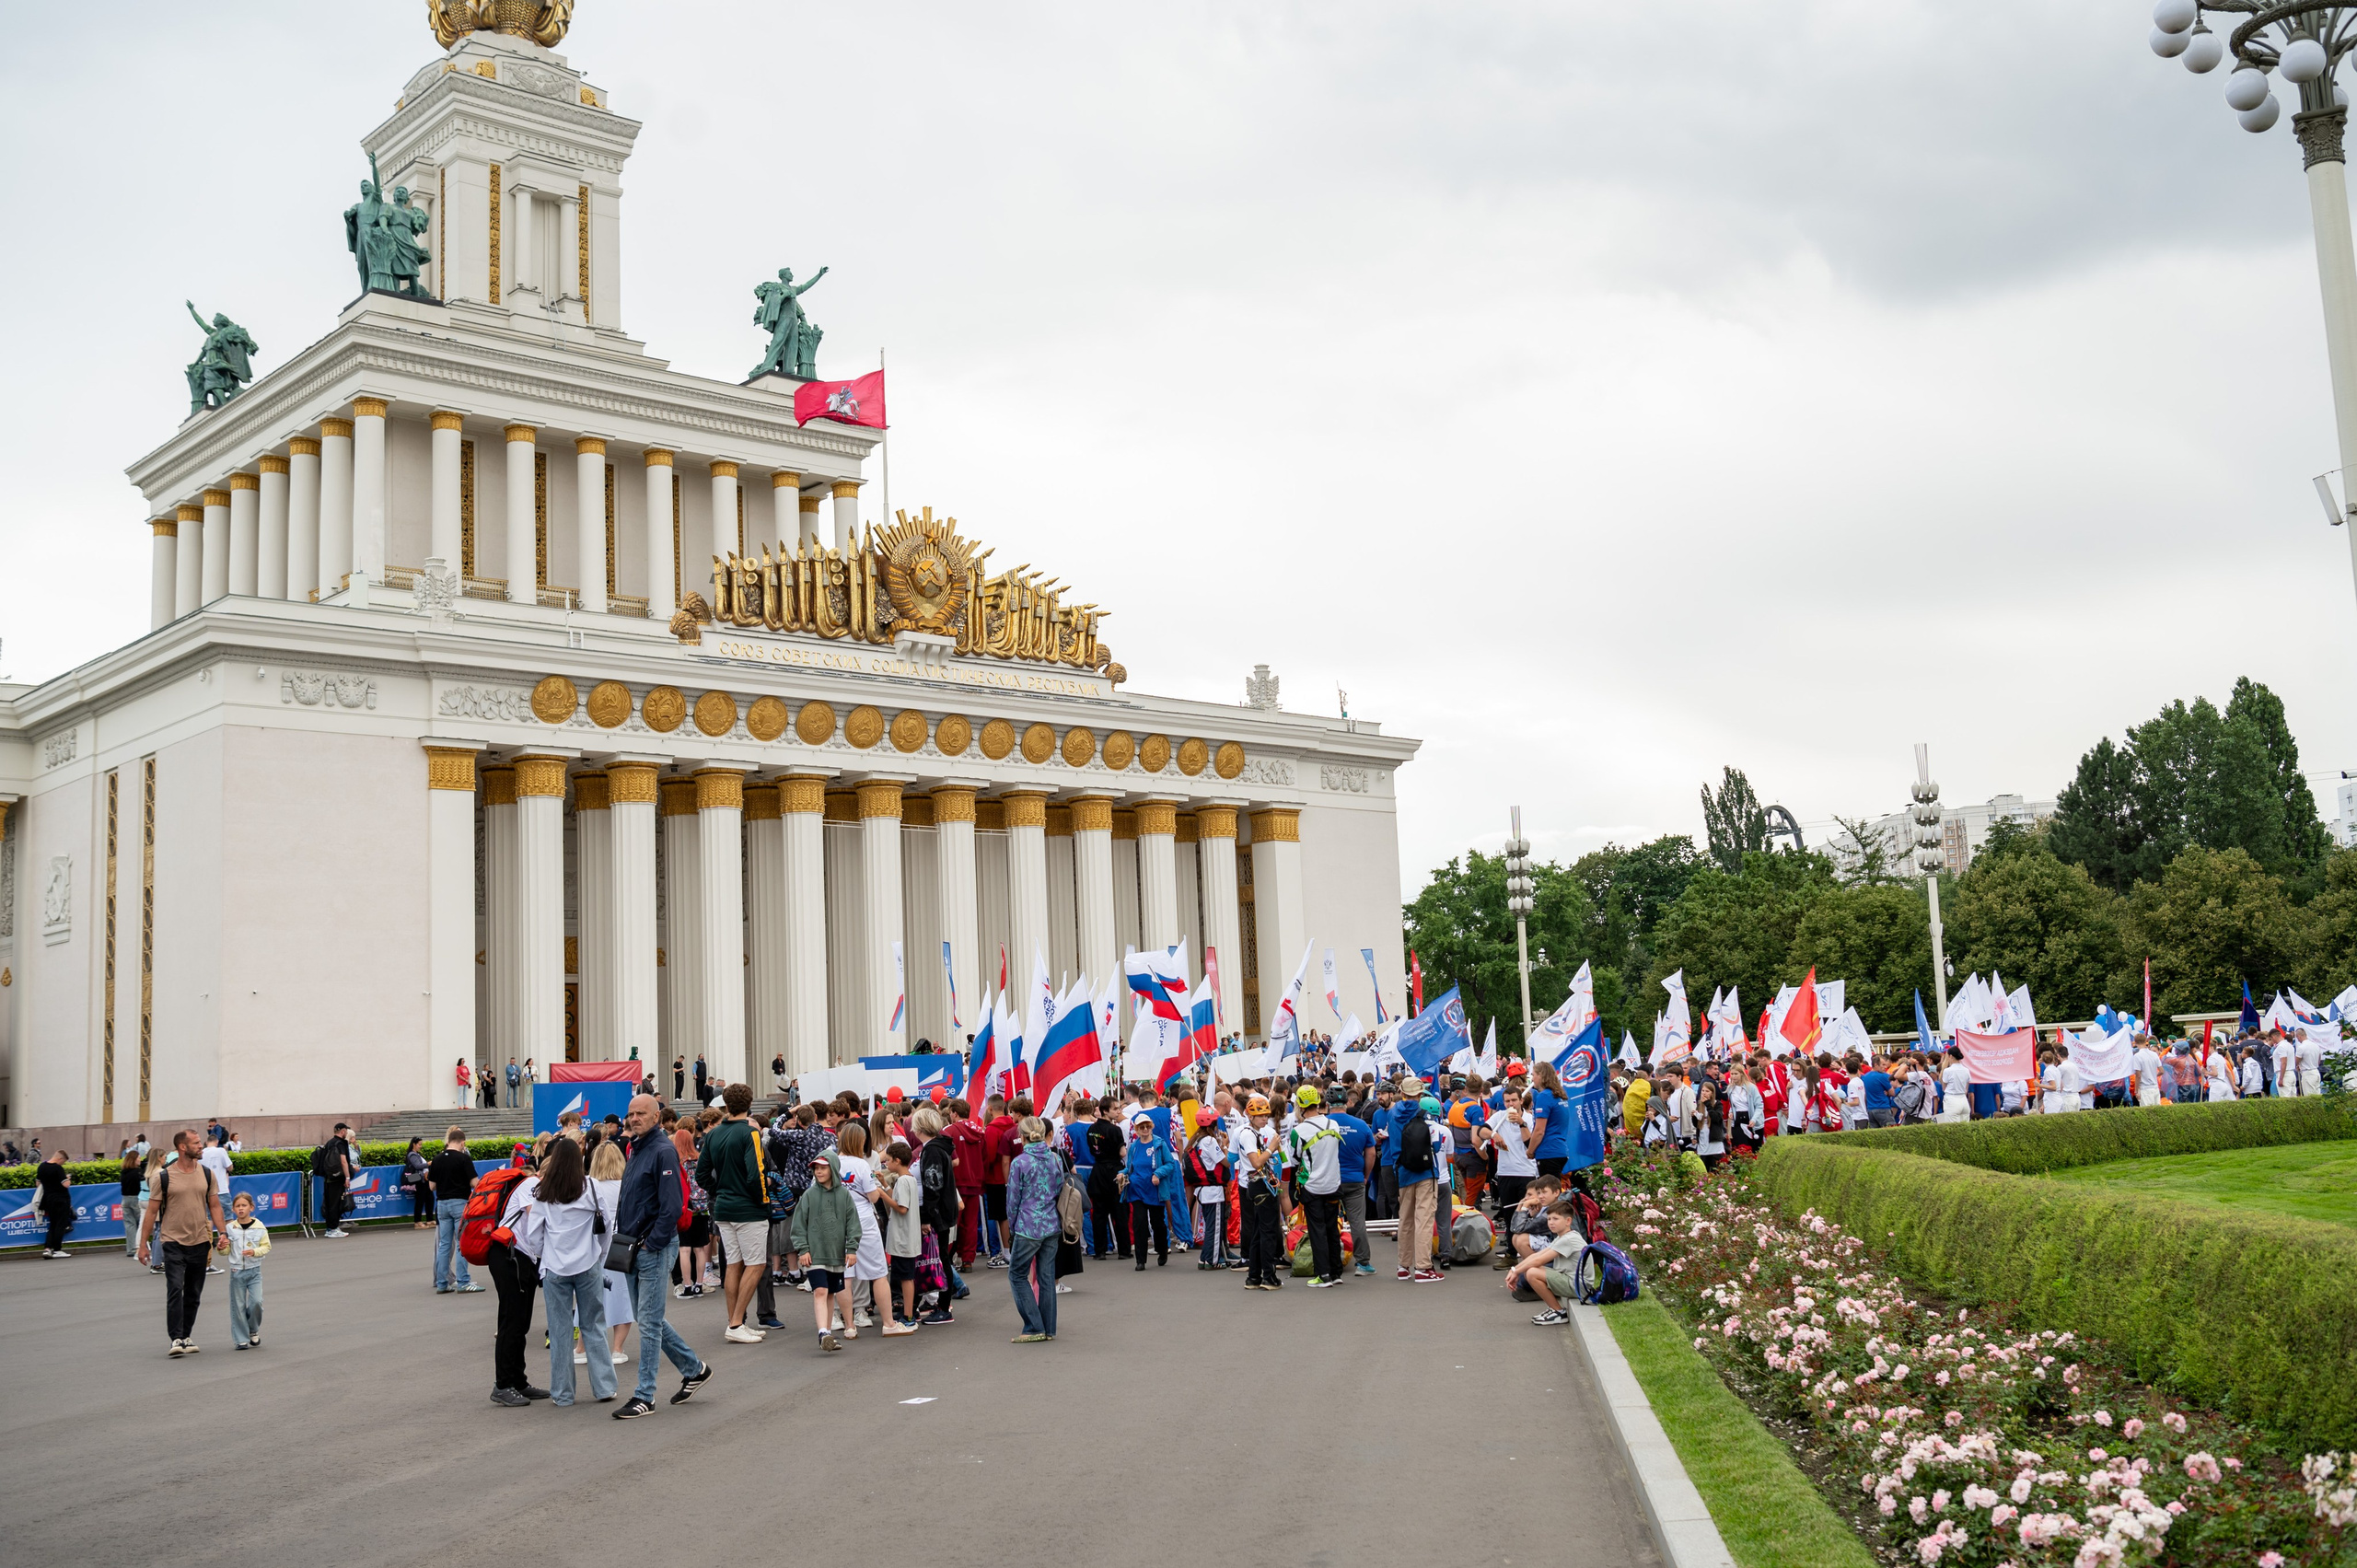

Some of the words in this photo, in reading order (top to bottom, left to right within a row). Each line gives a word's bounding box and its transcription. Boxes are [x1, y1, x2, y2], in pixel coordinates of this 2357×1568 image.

[719, 641, 764, 658] СОЮЗ
[772, 647, 862, 669] СОВЕТСКИХ
[871, 659, 1022, 687] СОЦИАЛИСТИЧЕСКИХ
[1028, 677, 1100, 696] РЕСПУБЛИК
[1574, 1104, 1587, 1132] России
